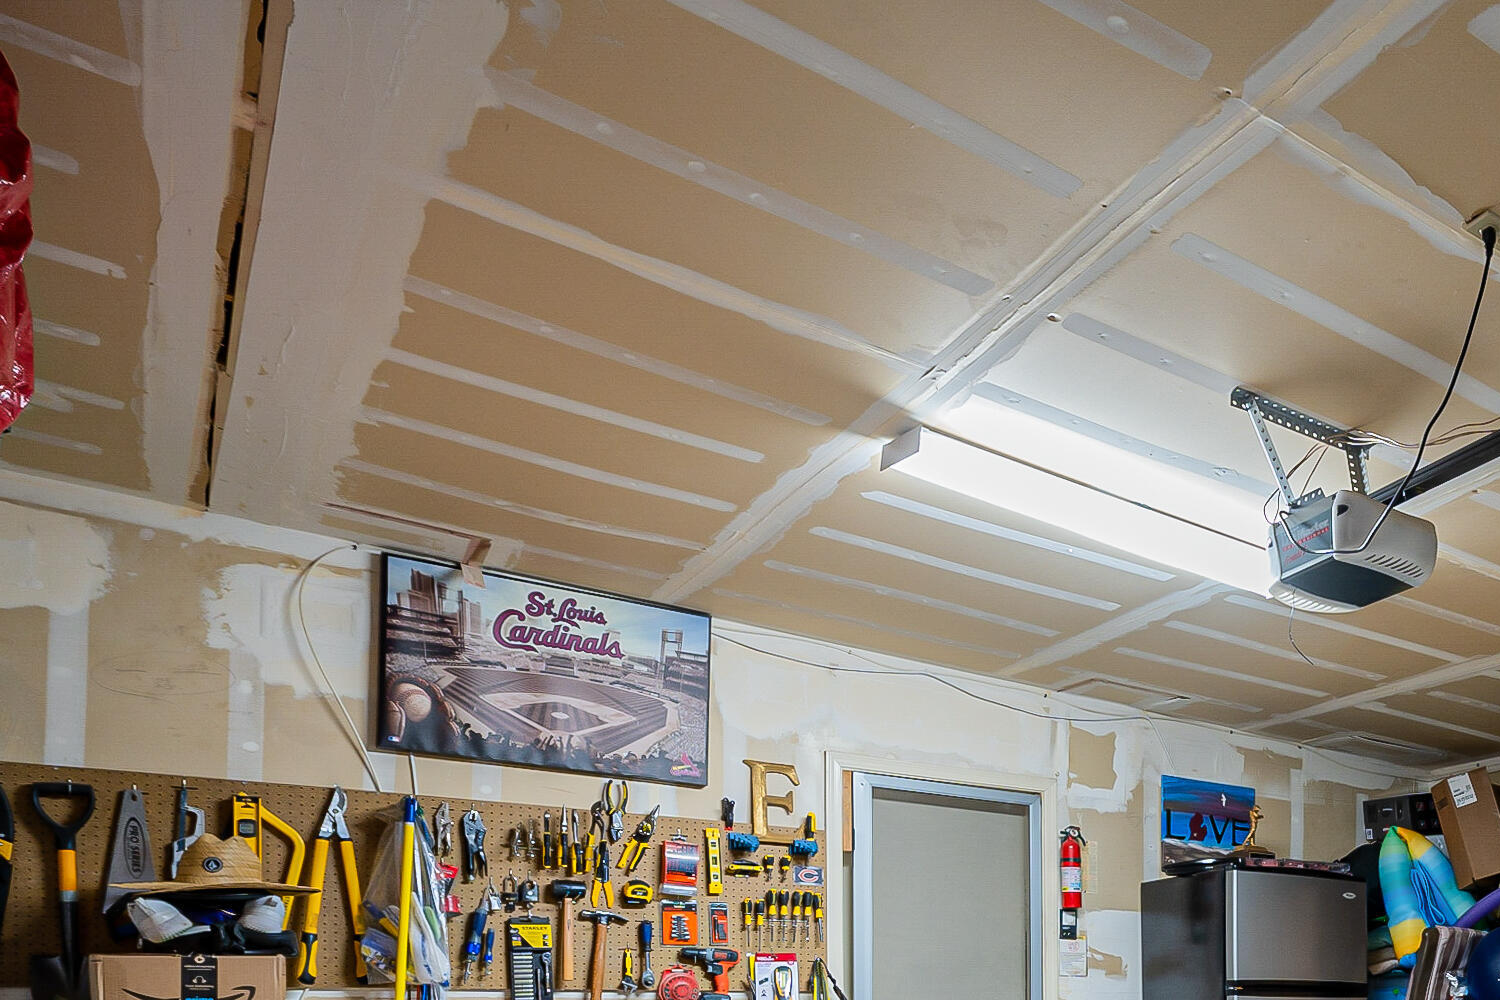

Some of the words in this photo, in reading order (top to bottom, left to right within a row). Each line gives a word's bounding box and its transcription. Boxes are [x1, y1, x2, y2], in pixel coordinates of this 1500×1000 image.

[551, 598, 607, 629] Louis
[493, 609, 626, 659] Cardinals
[130, 825, 140, 846] PRO
[131, 846, 141, 873] SERIES
